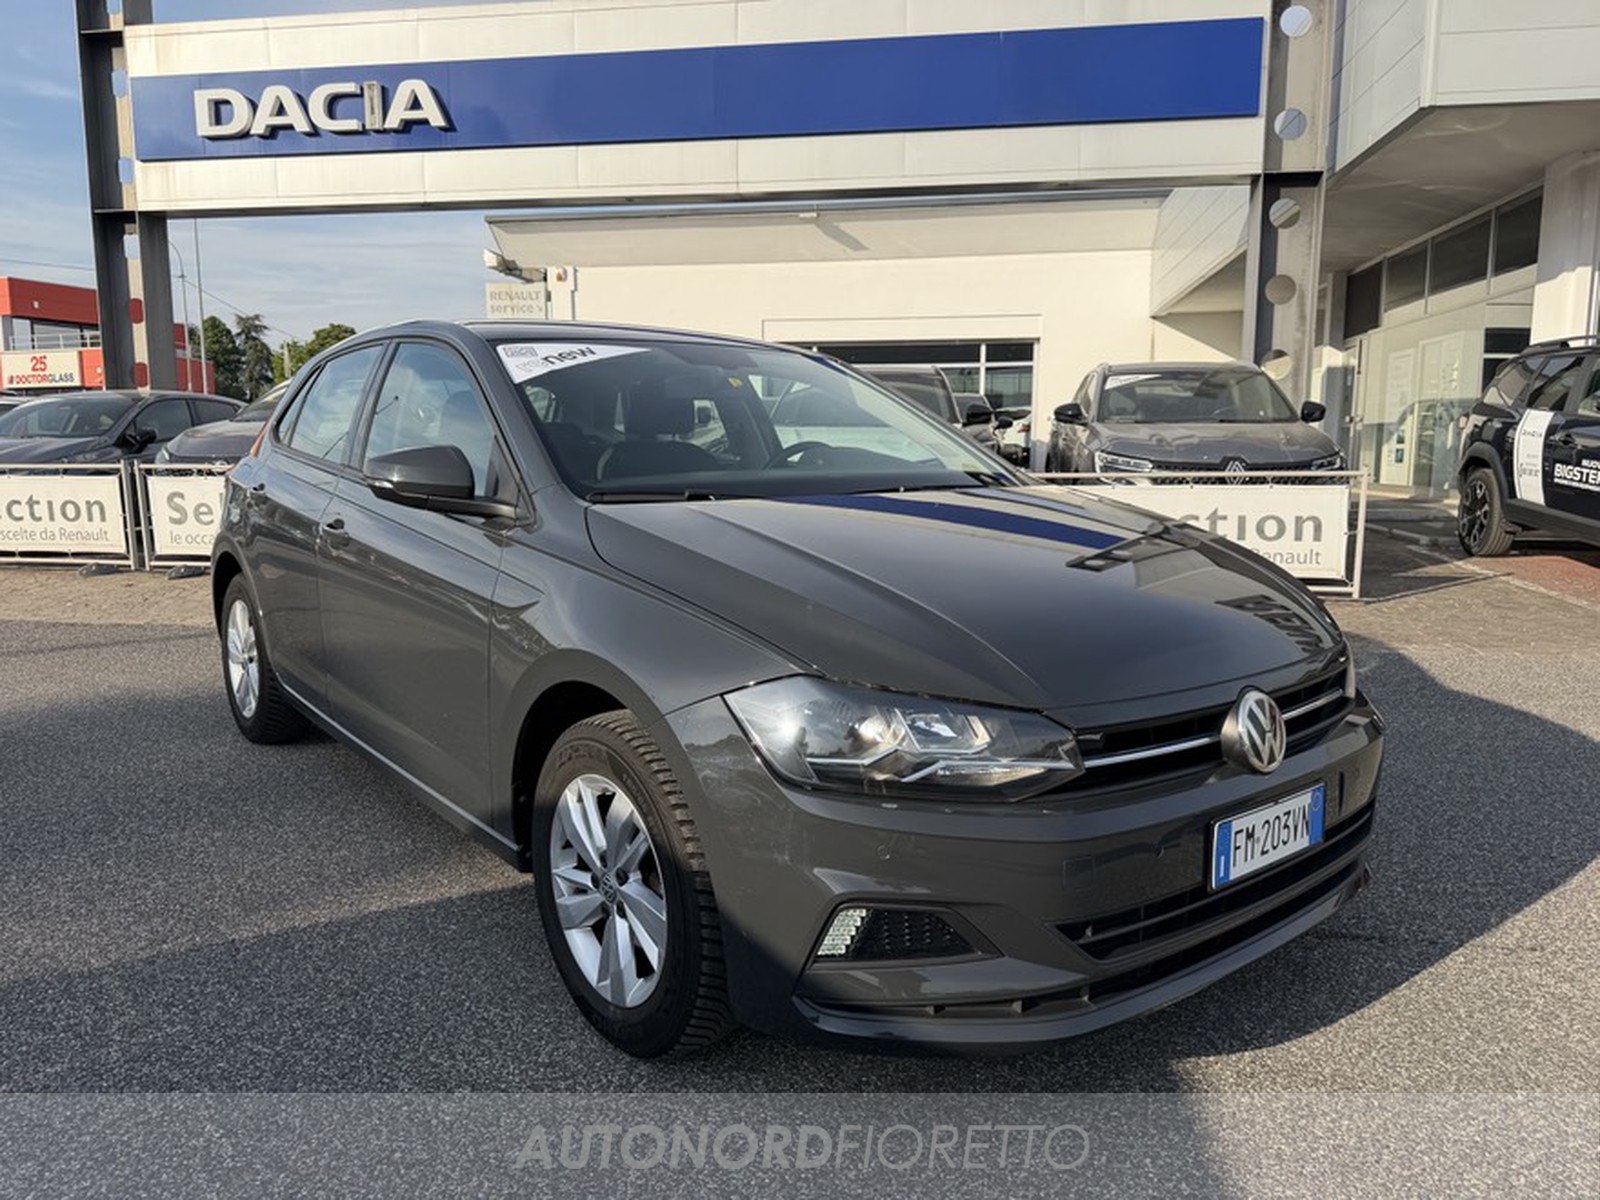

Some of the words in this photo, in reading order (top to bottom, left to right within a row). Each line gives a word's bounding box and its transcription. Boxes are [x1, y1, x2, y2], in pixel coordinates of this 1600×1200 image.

[193, 78, 449, 138] DACIA
[490, 291, 541, 301] RENAULT
[30, 355, 47, 372] 25
[1554, 463, 1600, 485] BIGSTE
[0, 494, 107, 522] ction
[40, 527, 56, 541] da
[59, 527, 109, 541] Renault
[169, 530, 182, 545] le
